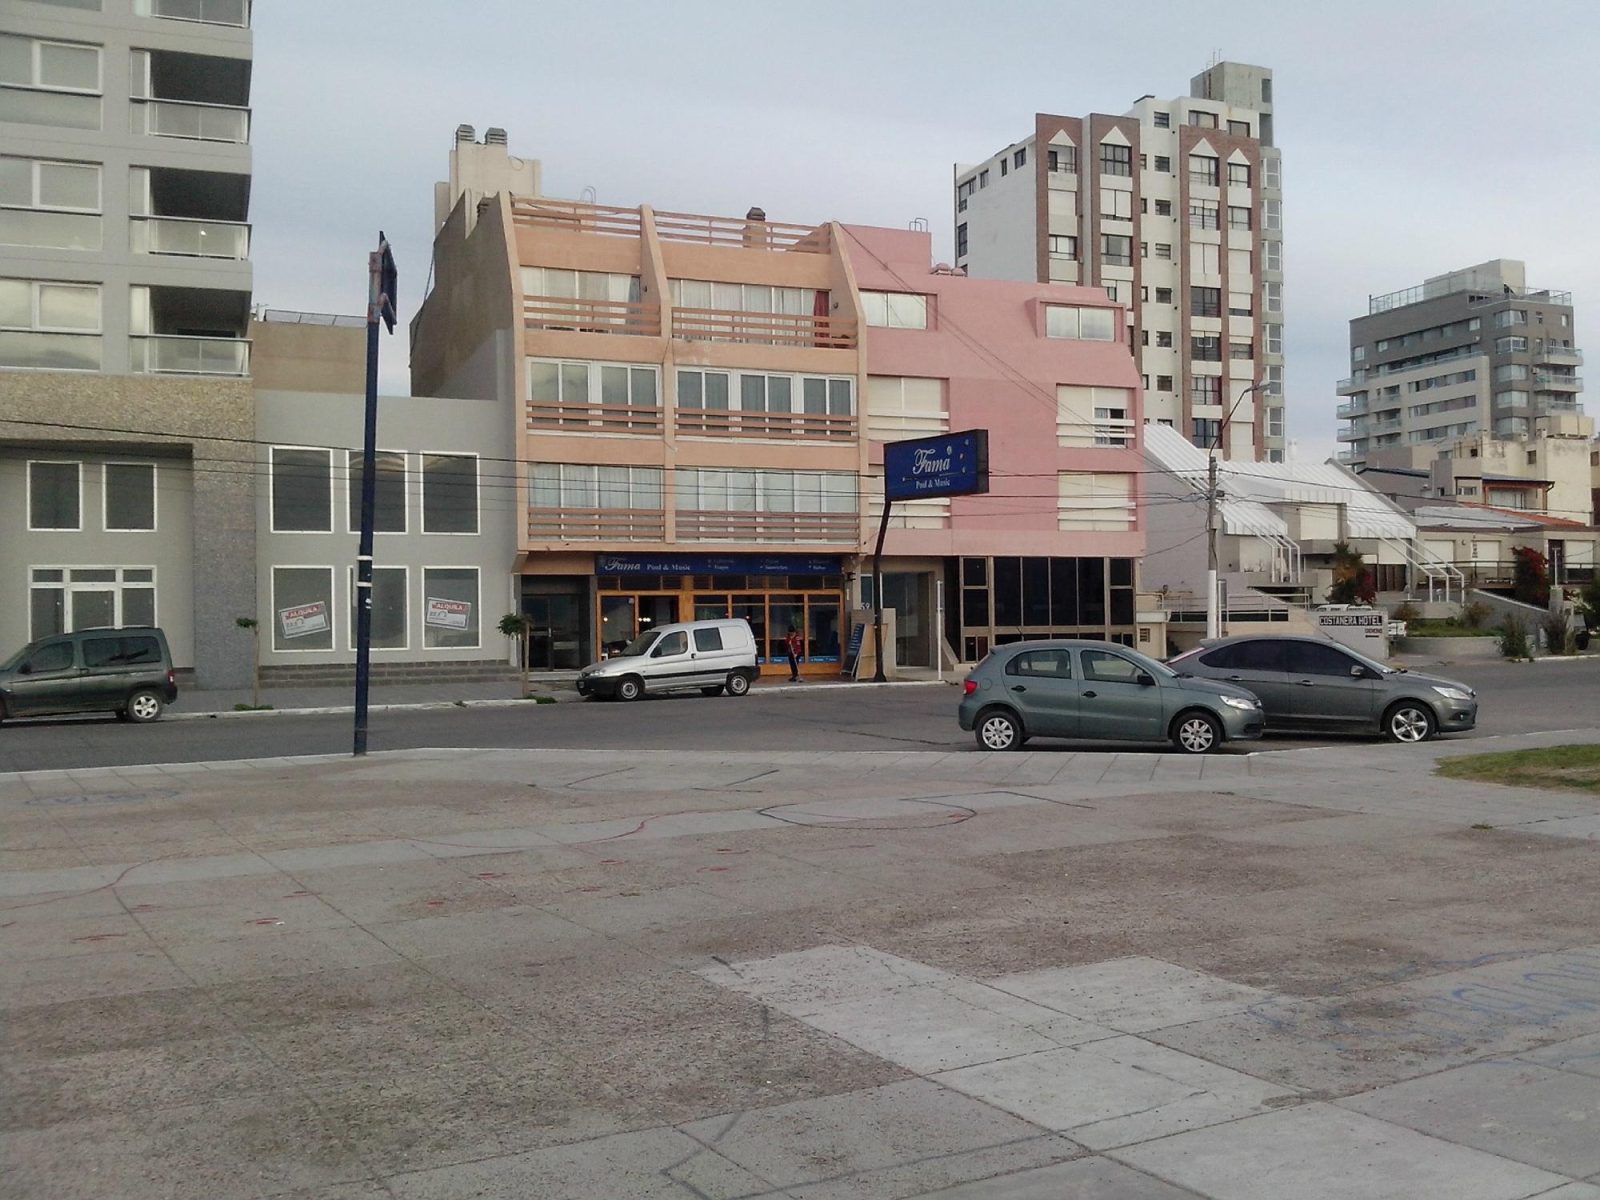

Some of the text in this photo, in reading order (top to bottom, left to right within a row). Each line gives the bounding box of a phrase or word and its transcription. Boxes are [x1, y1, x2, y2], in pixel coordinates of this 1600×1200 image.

[604, 557, 691, 571] Fama Pool & Music
[1319, 616, 1382, 626] COSTANERA HOTEL
